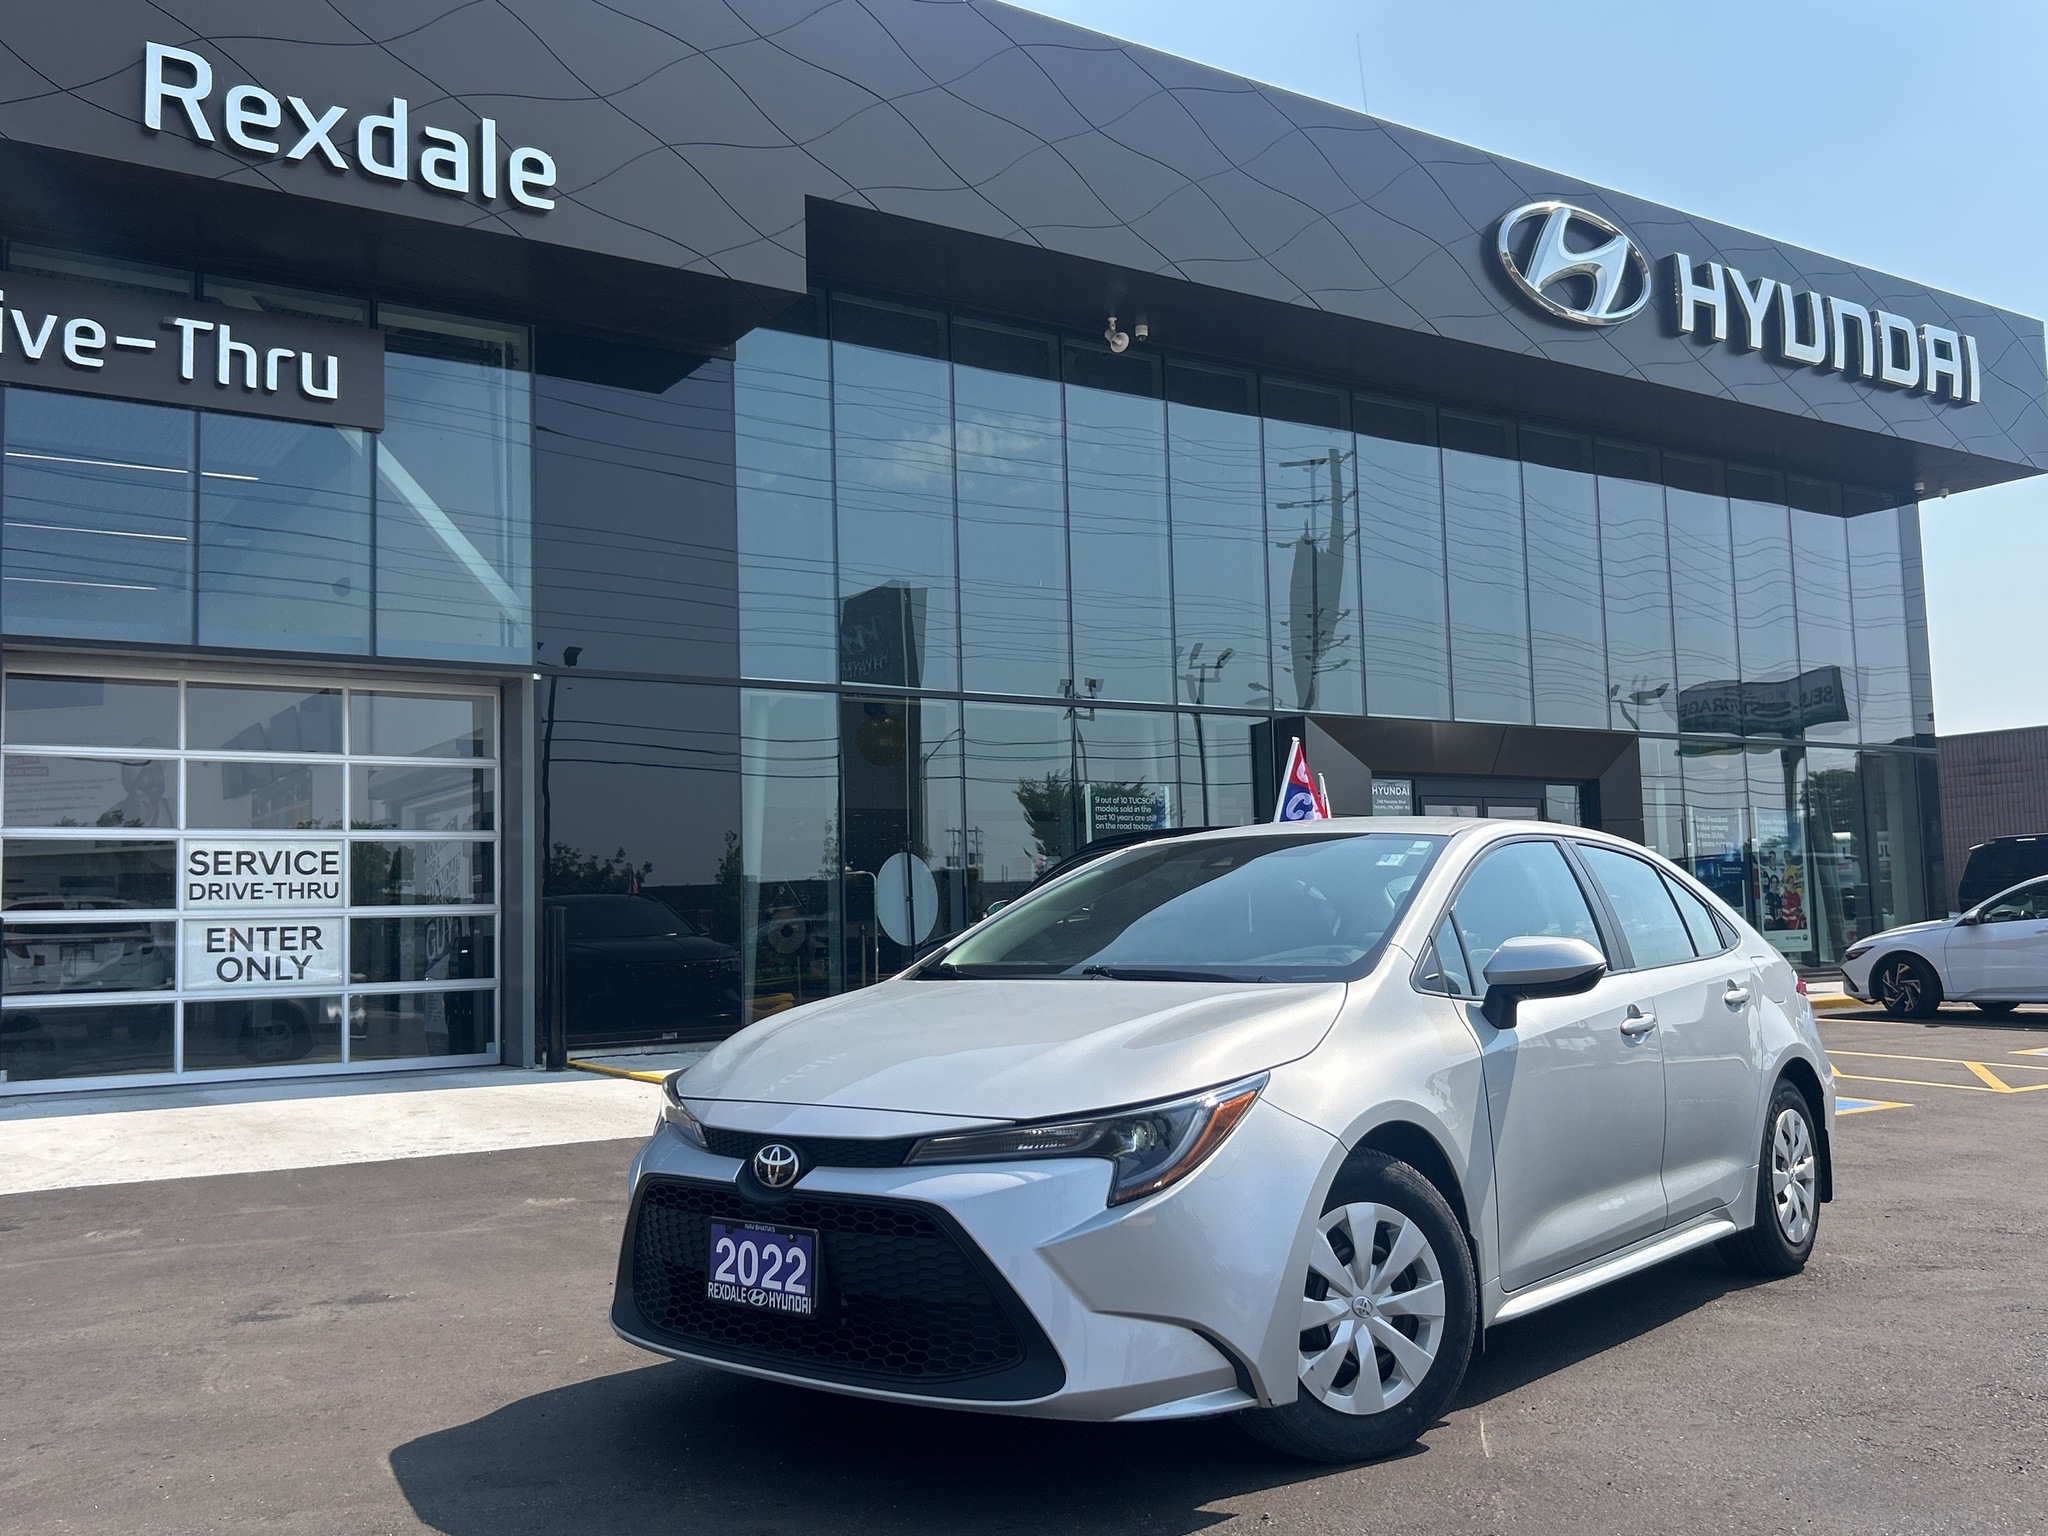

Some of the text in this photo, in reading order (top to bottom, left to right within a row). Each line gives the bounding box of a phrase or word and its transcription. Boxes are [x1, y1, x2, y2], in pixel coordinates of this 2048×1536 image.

[144, 40, 557, 211] Rexdale
[1674, 252, 1981, 404] HYUNDAI
[1094, 796, 1100, 804] 9
[1112, 796, 1119, 804] of
[1128, 797, 1156, 805] TUCSON
[1372, 787, 1410, 796] HYUNDAI
[1095, 805, 1152, 813] models sold in the
[1095, 813, 1107, 821] last
[1108, 813, 1116, 821] 10
[1117, 814, 1133, 822] years
[1146, 814, 1157, 822] still
[1105, 822, 1116, 830] the
[1117, 822, 1132, 830] road
[188, 850, 339, 876] SERVICE
[189, 882, 339, 900] DRIVE-THRU
[206, 926, 324, 953] ENTER
[216, 955, 313, 982] ONLY
[715, 1237, 807, 1294] 2022
[707, 1282, 812, 1314] REXDALE HYUNDAI
